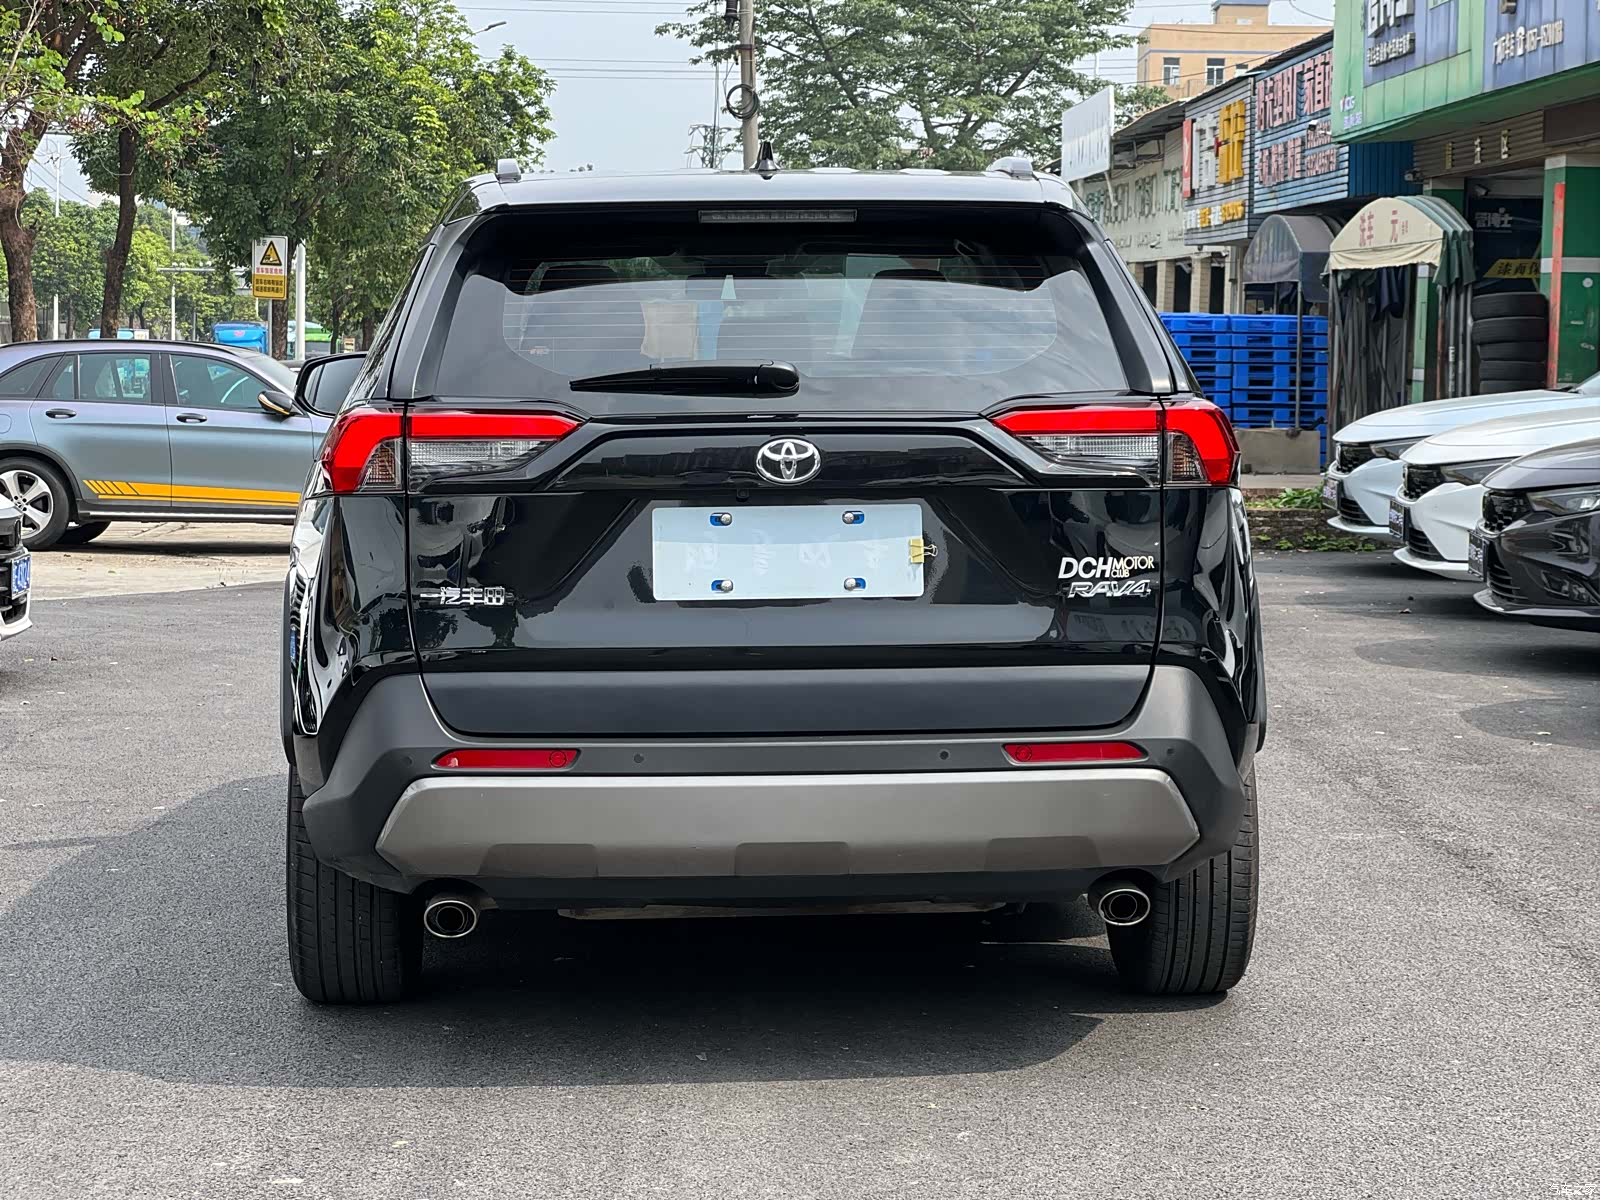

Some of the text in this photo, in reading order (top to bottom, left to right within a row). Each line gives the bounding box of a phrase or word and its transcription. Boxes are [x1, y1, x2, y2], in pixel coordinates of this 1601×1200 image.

[1058, 556, 1155, 579] DCH MOTOR
[1111, 568, 1130, 578] CLUB
[420, 587, 505, 605] 一汽丰田
[1067, 580, 1151, 598] RAV4
